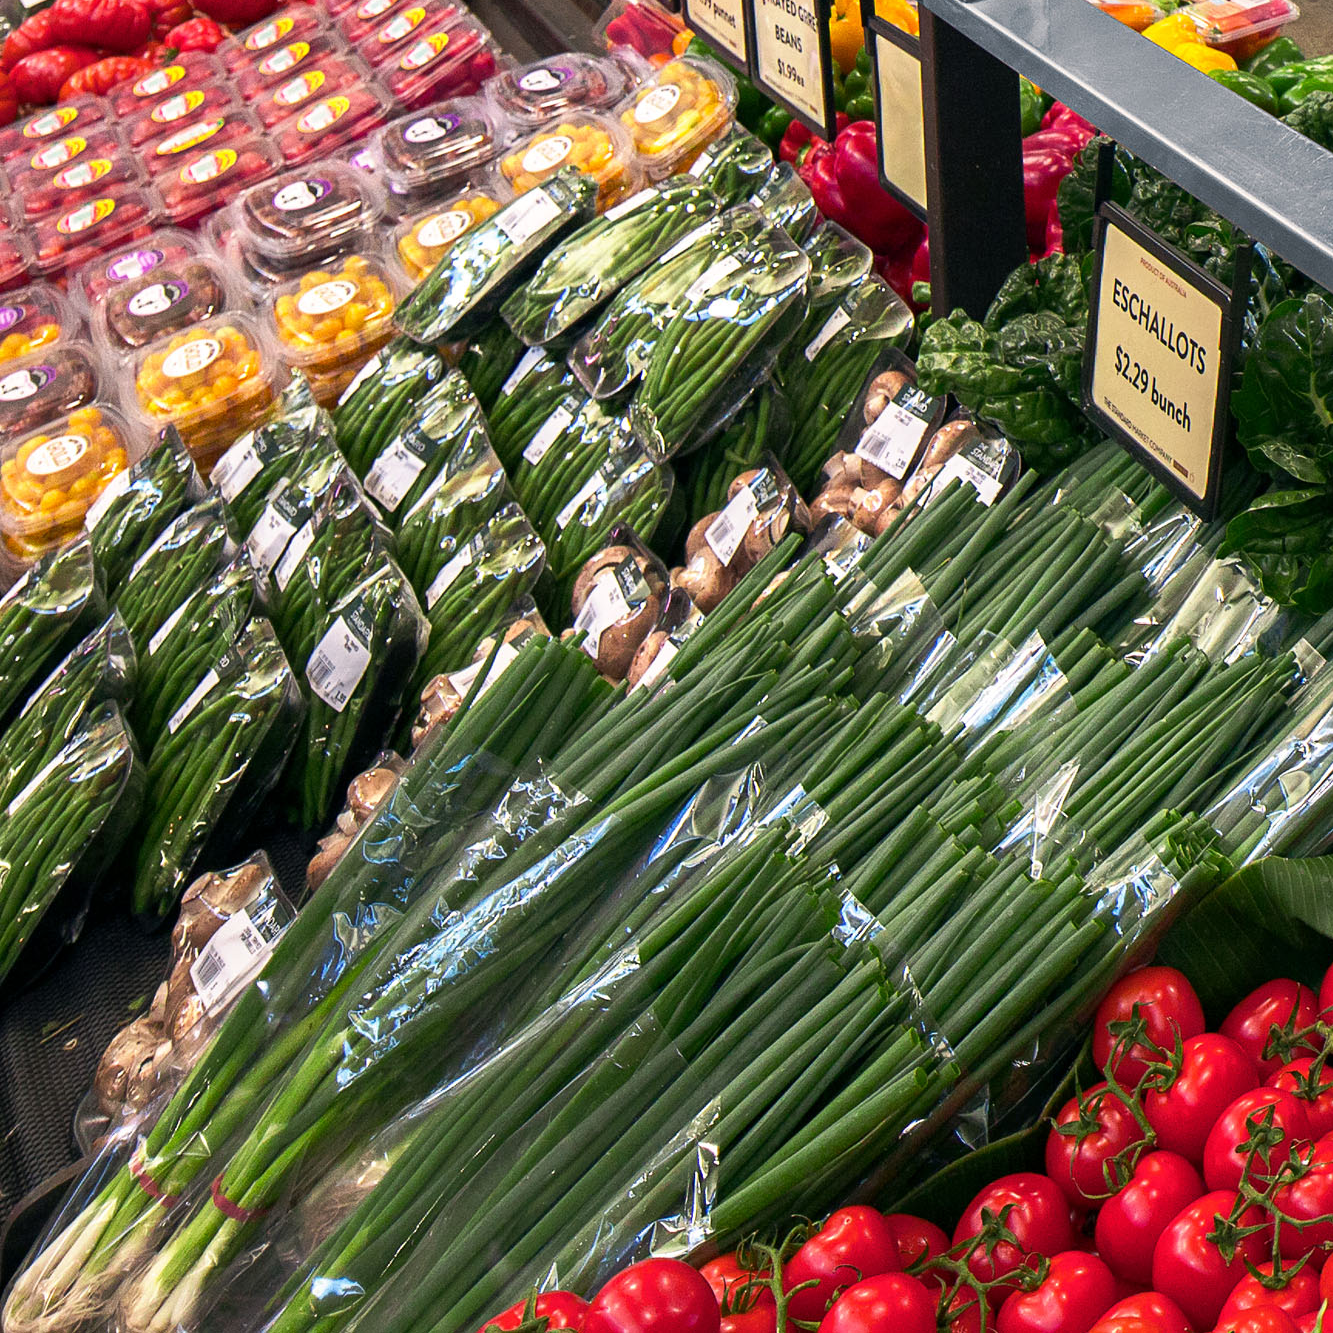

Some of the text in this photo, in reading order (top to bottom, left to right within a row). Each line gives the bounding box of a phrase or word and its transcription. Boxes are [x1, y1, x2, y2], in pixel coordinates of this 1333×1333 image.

[713, 0, 736, 29] punnet
[774, 25, 803, 53] BEANS
[777, 58, 805, 87] $1.99ea
[1140, 257, 1159, 276] PRODUCT
[1165, 278, 1187, 299] AUSTRALIA
[1113, 277, 1207, 375] ESCHALLOTS
[1114, 345, 1191, 433] $2.29 bunch
[1104, 396, 1173, 465] THE STANDARD MARKET COMPANY
